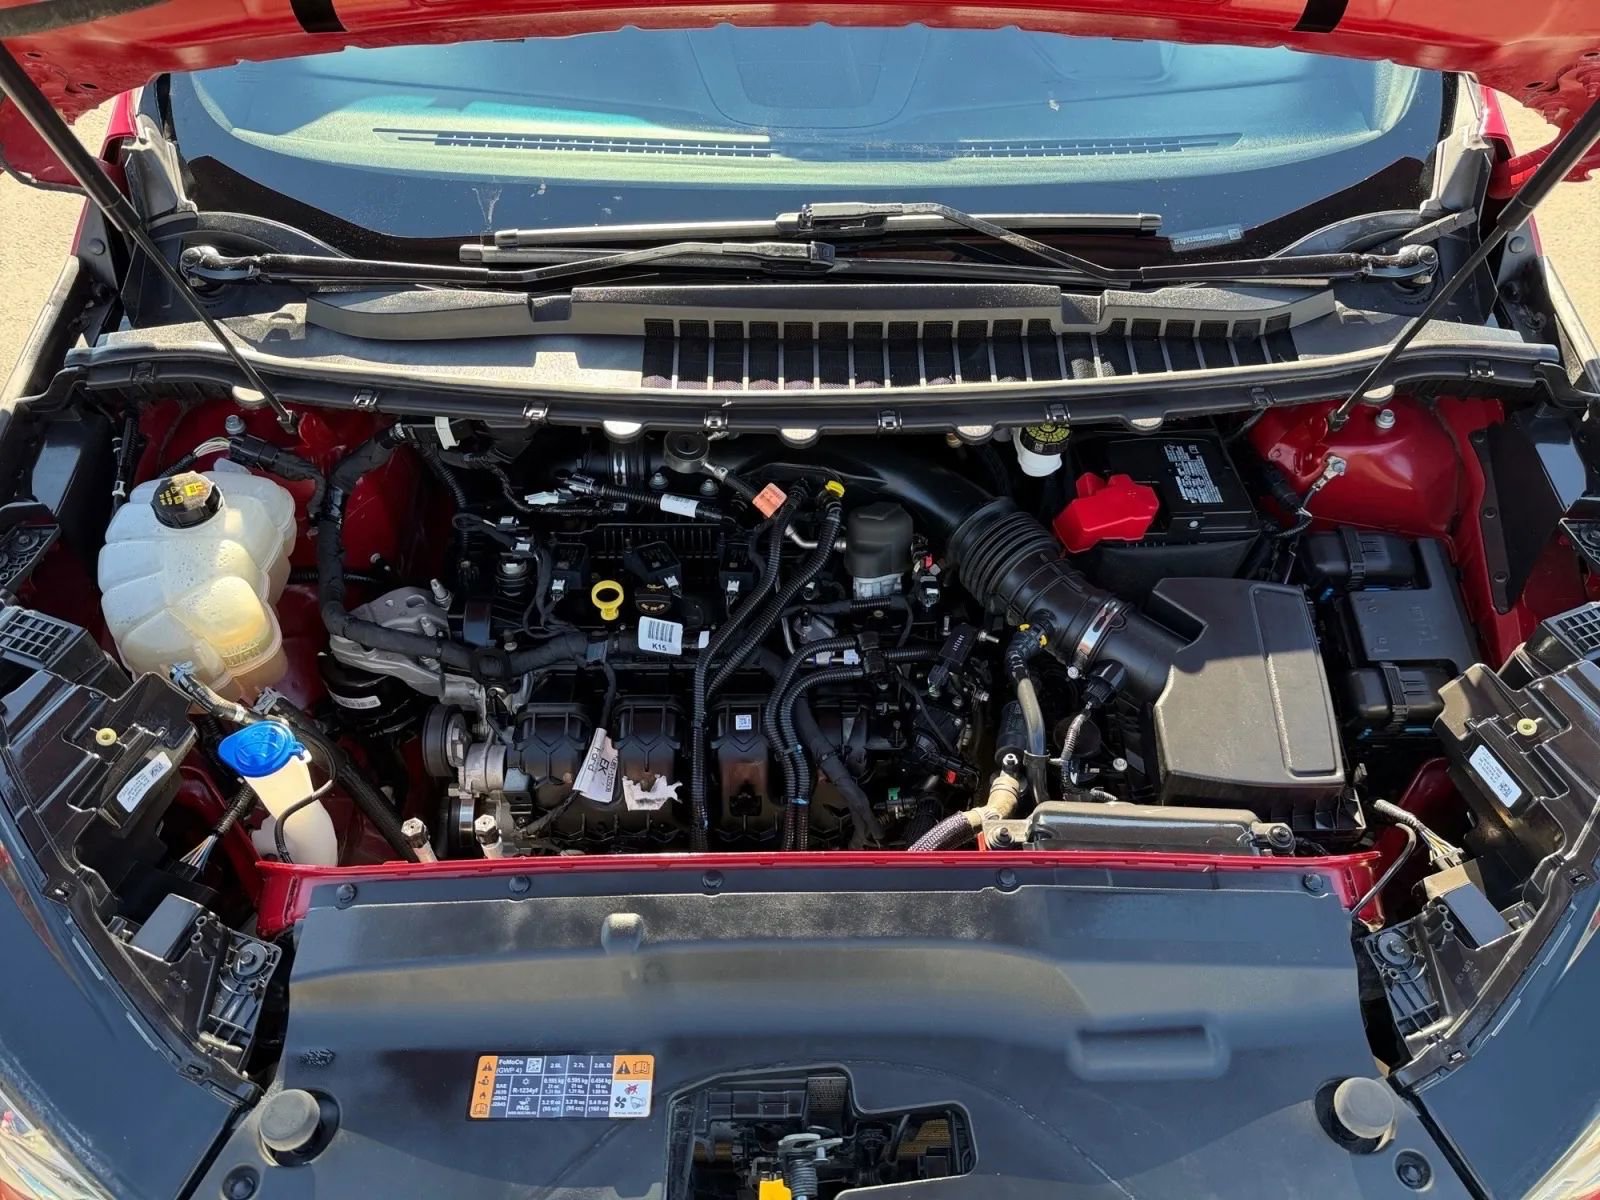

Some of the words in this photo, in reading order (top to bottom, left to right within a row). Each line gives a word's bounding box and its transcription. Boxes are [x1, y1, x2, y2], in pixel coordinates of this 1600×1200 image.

[652, 643, 667, 651] K15
[587, 746, 601, 772] Ford
[598, 758, 610, 776] EK
